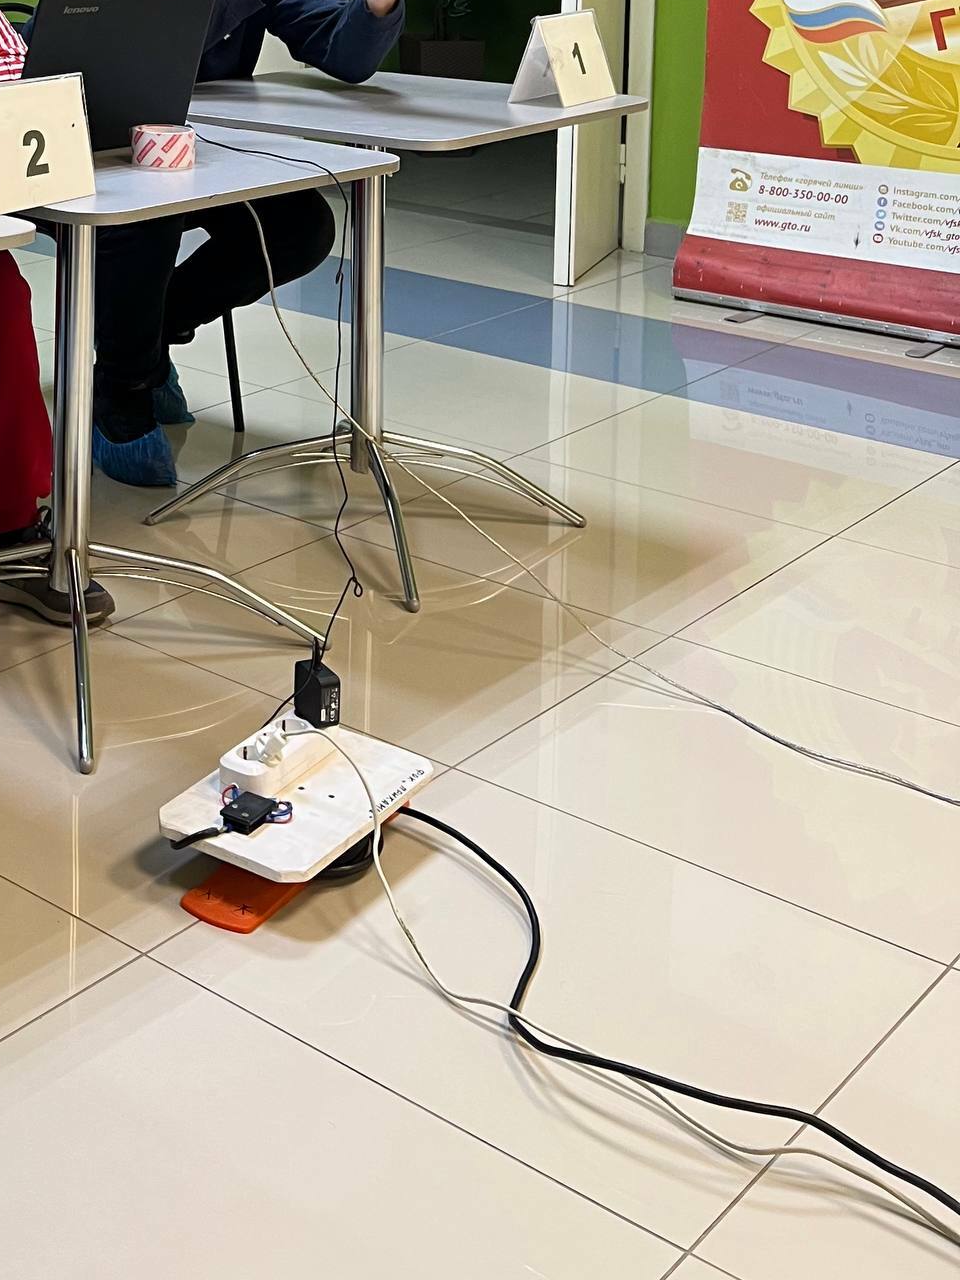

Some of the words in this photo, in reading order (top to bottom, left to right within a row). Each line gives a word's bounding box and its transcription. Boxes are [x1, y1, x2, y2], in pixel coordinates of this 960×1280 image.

[571, 42, 587, 75] 1
[22, 130, 50, 178] 2
[760, 172, 793, 183] Телефон
[758, 184, 849, 205] 8-800-350-00-00
[756, 204, 812, 217] официальный
[813, 211, 836, 221] сайт
[892, 200, 960, 215] Facebook.com/
[754, 218, 811, 232] www.gto.ru
